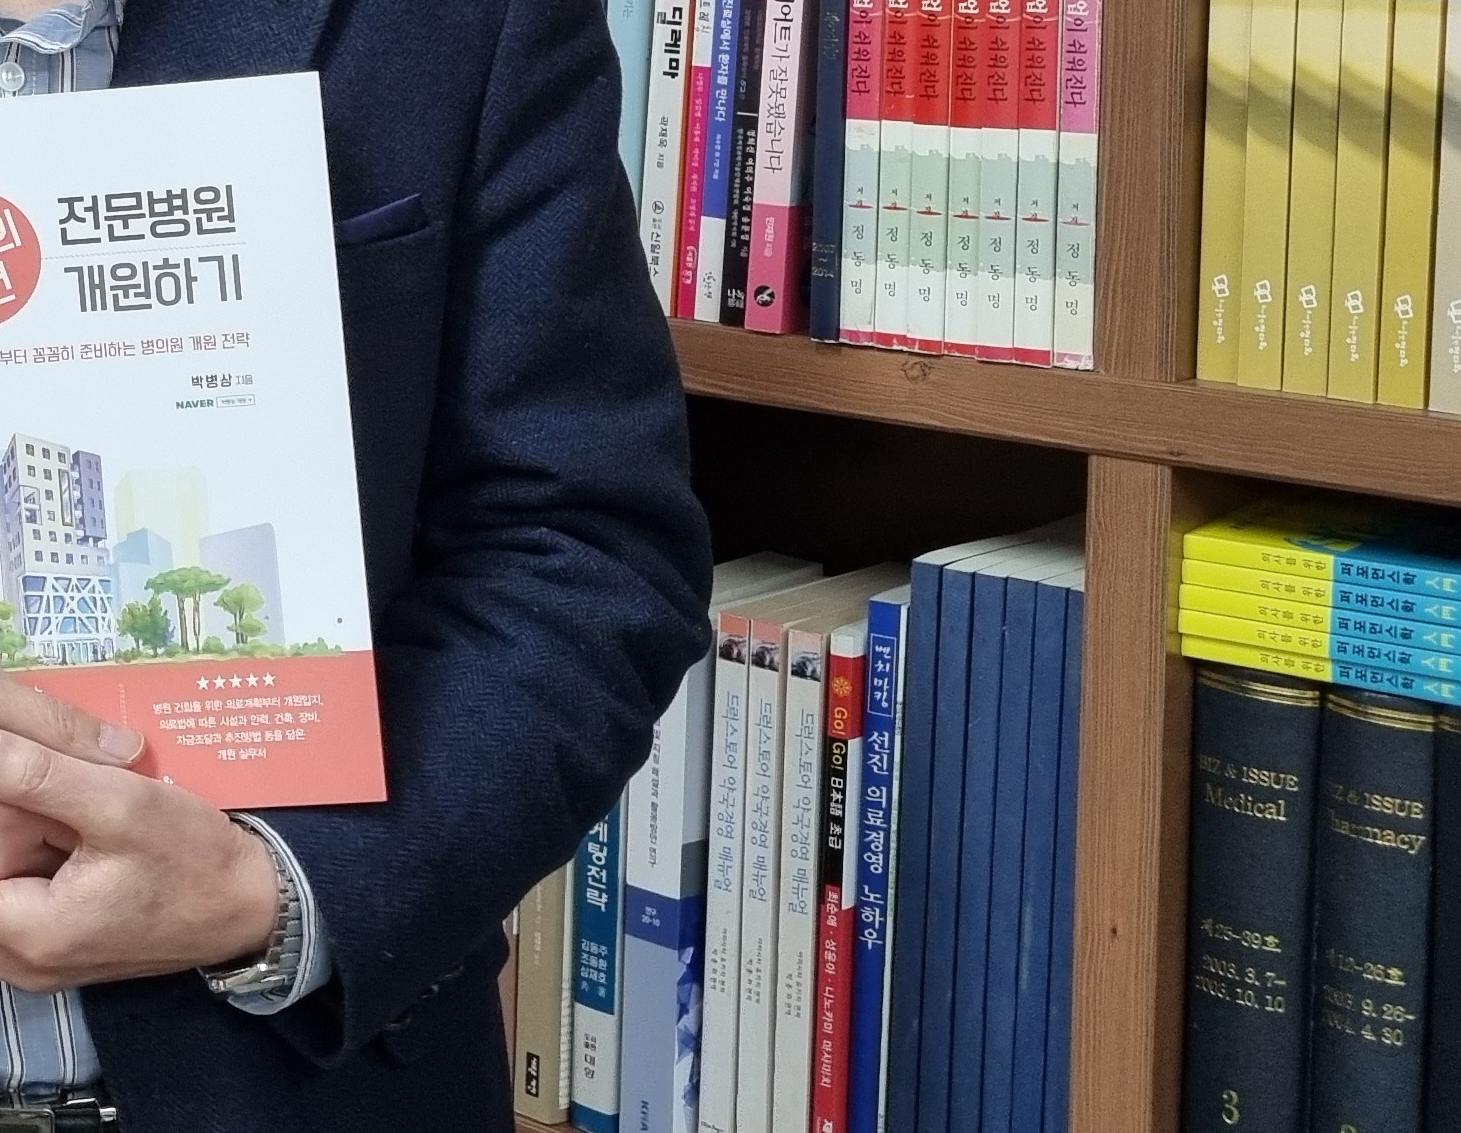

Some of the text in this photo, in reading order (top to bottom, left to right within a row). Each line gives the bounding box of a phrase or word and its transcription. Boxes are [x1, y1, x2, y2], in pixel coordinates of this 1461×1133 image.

[656, 5, 685, 80] 딜레마
[716, 53, 730, 89] 환자를
[851, 31, 872, 98] 쉬워진다
[1064, 38, 1088, 109] 쉬워진다
[714, 89, 728, 122] 만나다
[764, 65, 789, 175] 잘못됐습니다
[56, 184, 237, 246] 전문병원
[63, 254, 243, 313] 개원하기
[0, 348, 29, 366] 부터
[32, 345, 75, 364] 꼼꼼히
[79, 341, 136, 361] 준비하는
[140, 336, 184, 357] 병의원
[189, 334, 217, 353] 개원
[221, 331, 251, 349] 전략
[190, 373, 233, 390] 박병상
[175, 398, 214, 410] NAVER
[1260, 552, 1297, 566] 의사를
[1302, 557, 1327, 572] 위한
[872, 644, 892, 708] 벤치마킹
[198, 716, 218, 729] 따른
[205, 699, 223, 712] 위한
[831, 706, 848, 736] Go!
[217, 747, 267, 761] 개원 실무서
[828, 741, 846, 851] Go! 日本語 초급
[1241, 766, 1299, 792] ISSUE
[787, 708, 815, 916] 드럭스토어 약국경영 매뉴얼
[1205, 782, 1287, 822] Medical
[1363, 792, 1425, 819] ISSUE
[859, 729, 890, 950] 선진 의료경영 노하우
[1221, 1089, 1240, 1125] 3
